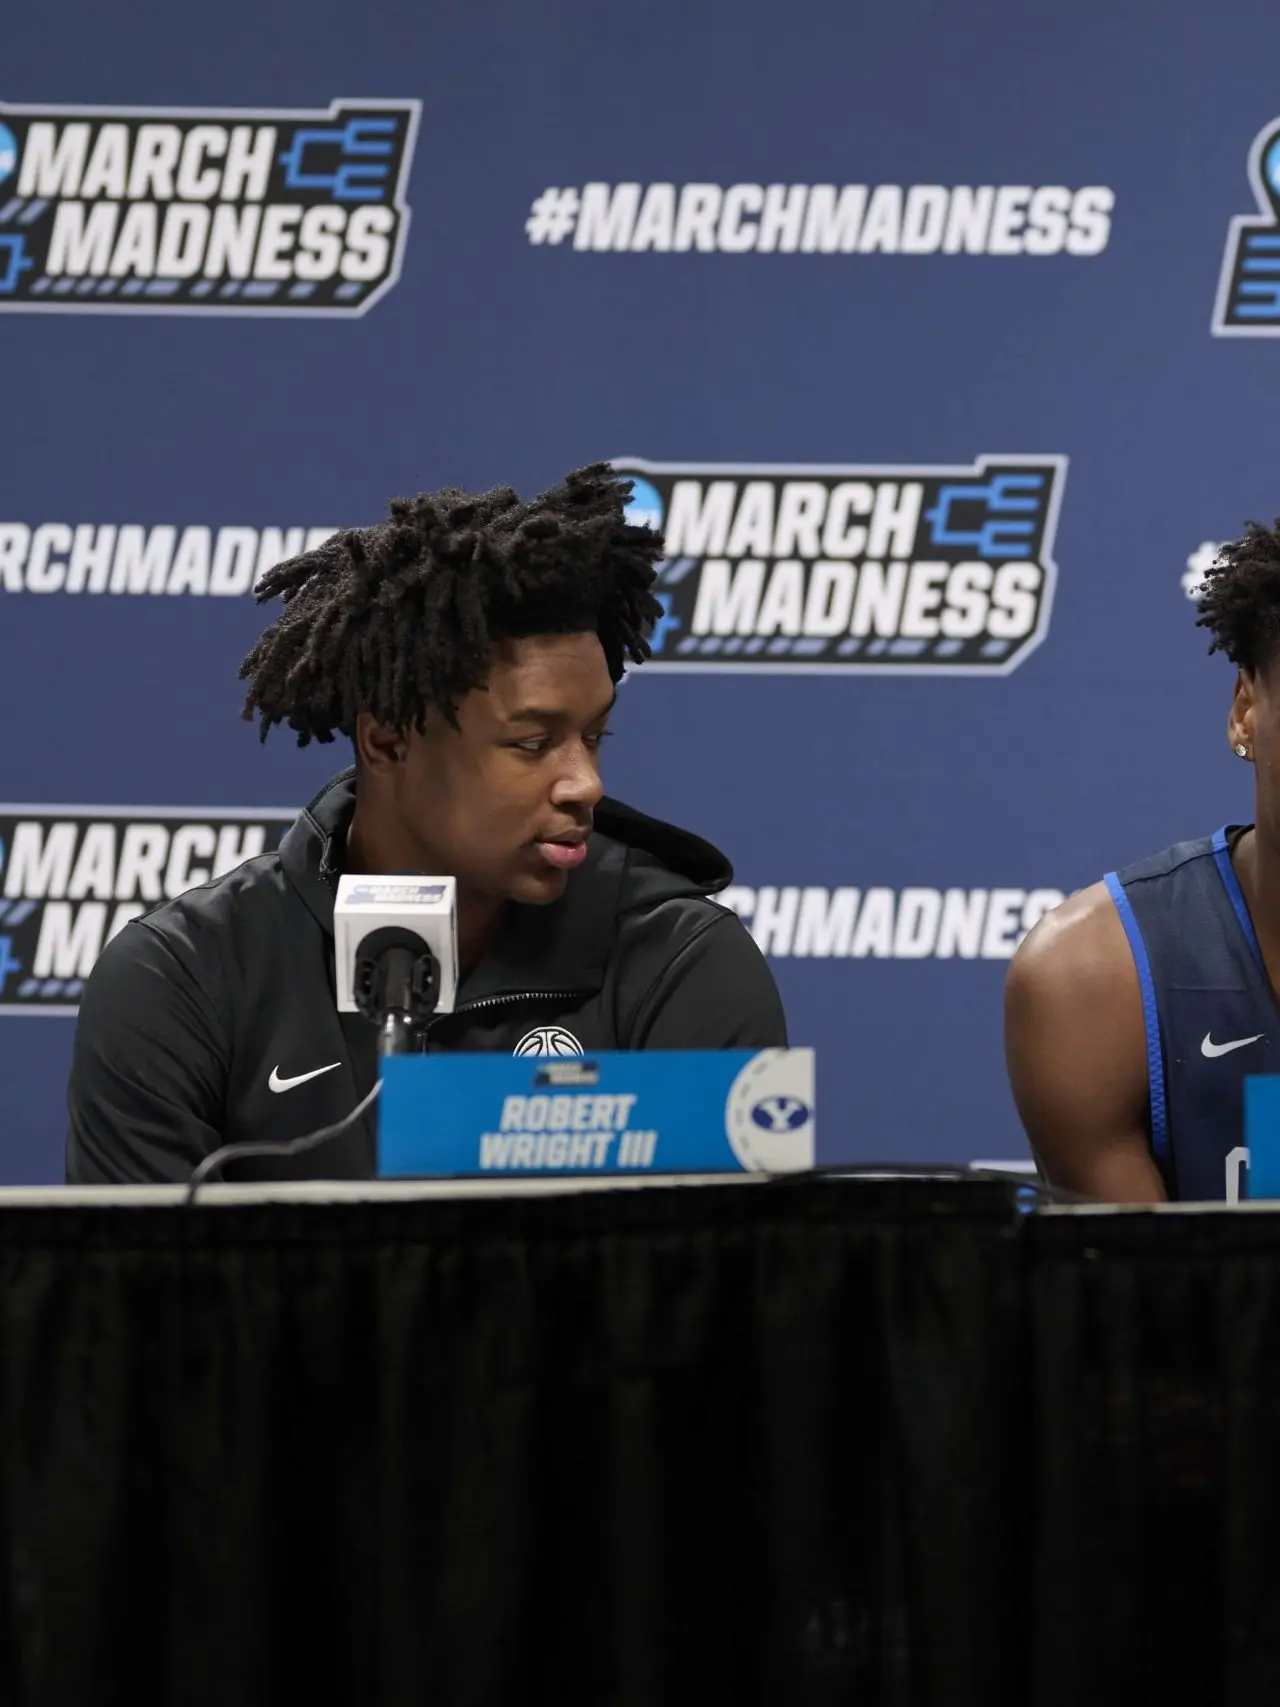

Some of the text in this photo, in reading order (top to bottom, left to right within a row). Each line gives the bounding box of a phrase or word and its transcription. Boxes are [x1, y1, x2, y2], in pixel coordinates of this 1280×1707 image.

[18, 122, 277, 199] MARCH
[45, 201, 395, 282] MADNESS
[525, 182, 1115, 256] #MARCHMADNESS
[663, 480, 924, 559] MARCH
[0, 522, 342, 596] RCHMADN
[691, 560, 1041, 638] MADNESS
[4, 822, 266, 900] MARCH
[480, 1131, 658, 1169] WRIGHT III
[501, 1094, 637, 1131] ROBERT
